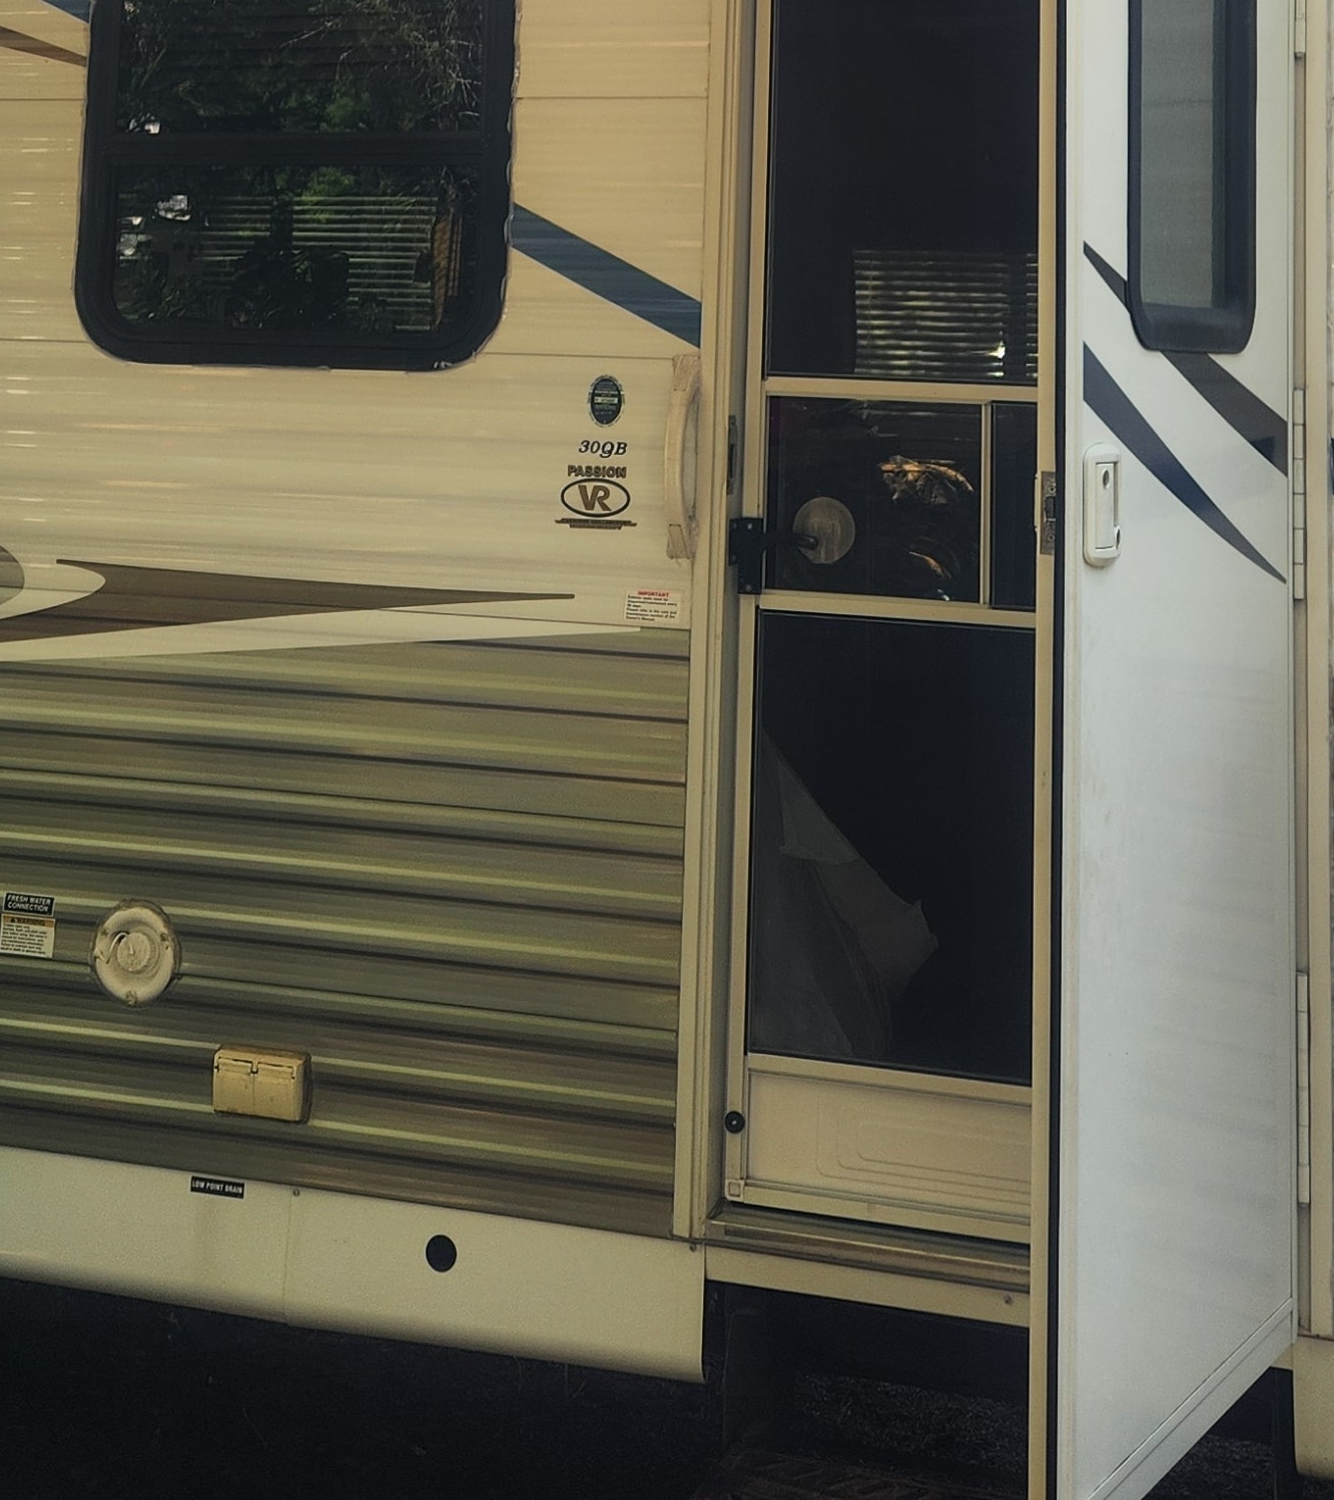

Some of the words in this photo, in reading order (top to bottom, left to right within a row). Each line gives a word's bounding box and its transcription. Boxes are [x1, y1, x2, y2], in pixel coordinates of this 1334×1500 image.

[579, 440, 628, 459] 30QB
[568, 465, 627, 478] PASSION
[578, 485, 612, 511] VR
[7, 894, 28, 903] FRESH
[29, 897, 51, 906] WATER
[7, 901, 49, 912] CONNECTION
[192, 1180, 205, 1188] LOW
[206, 1181, 224, 1191] POINT
